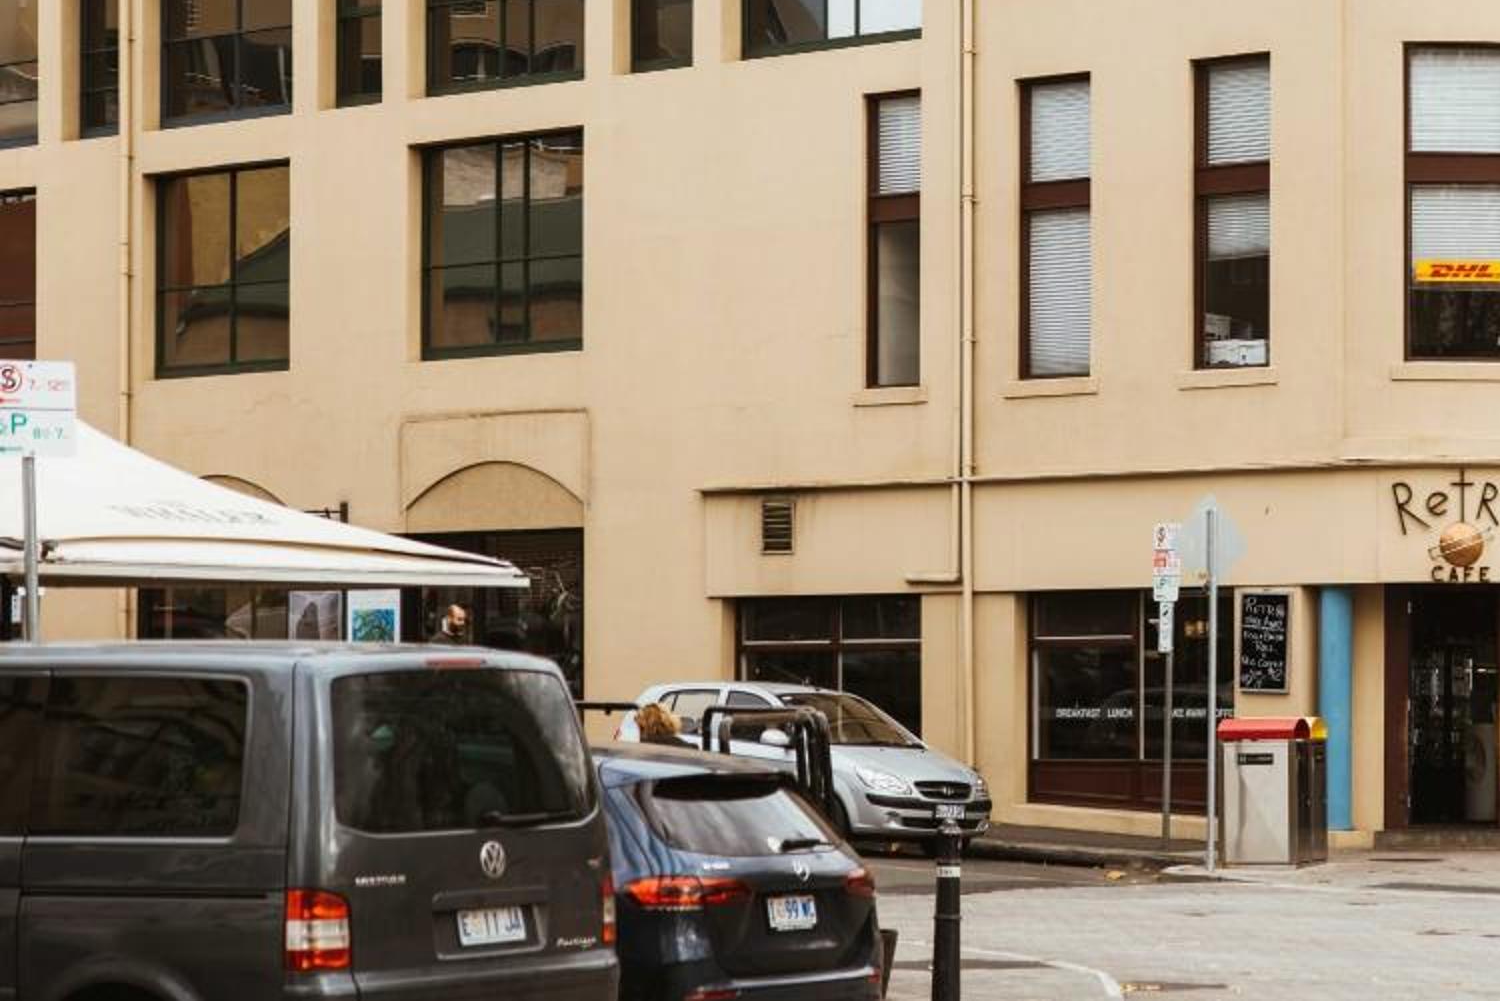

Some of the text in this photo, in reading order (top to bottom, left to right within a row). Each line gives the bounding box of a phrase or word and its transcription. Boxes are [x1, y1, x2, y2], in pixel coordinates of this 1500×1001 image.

[1430, 263, 1494, 278] DHL
[1430, 565, 1492, 583] CAFE
[1055, 707, 1101, 719] BREAKFAST
[1106, 707, 1134, 719] LUNCH
